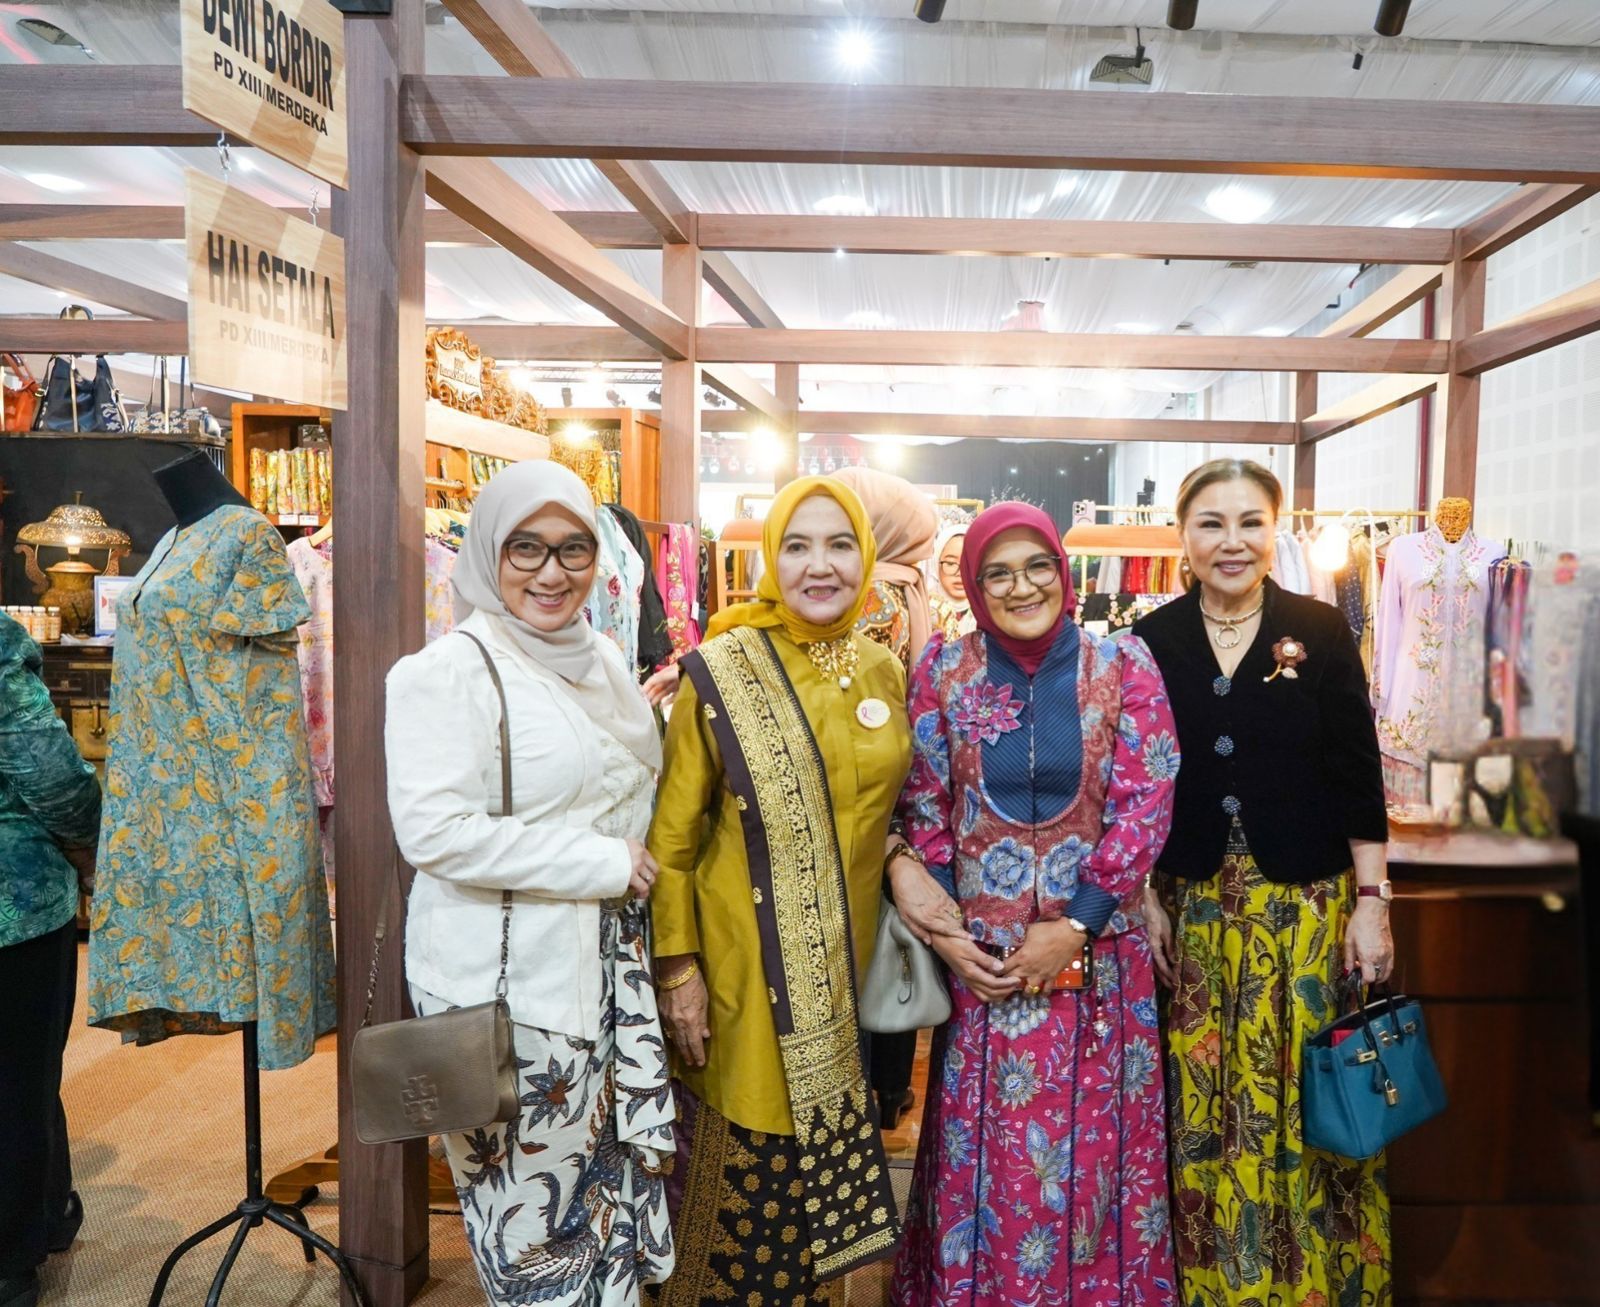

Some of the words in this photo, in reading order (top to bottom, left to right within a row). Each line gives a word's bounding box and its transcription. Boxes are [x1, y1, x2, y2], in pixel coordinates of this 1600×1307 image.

[214, 51, 233, 79] PD
[238, 66, 328, 136] XIII/MERDEKA
[263, 0, 334, 112] BORDIR
[208, 230, 250, 314] HAI
[257, 250, 335, 339] SETALA
[219, 319, 239, 342] PD
[243, 327, 329, 365] XIII/MERDEKA
